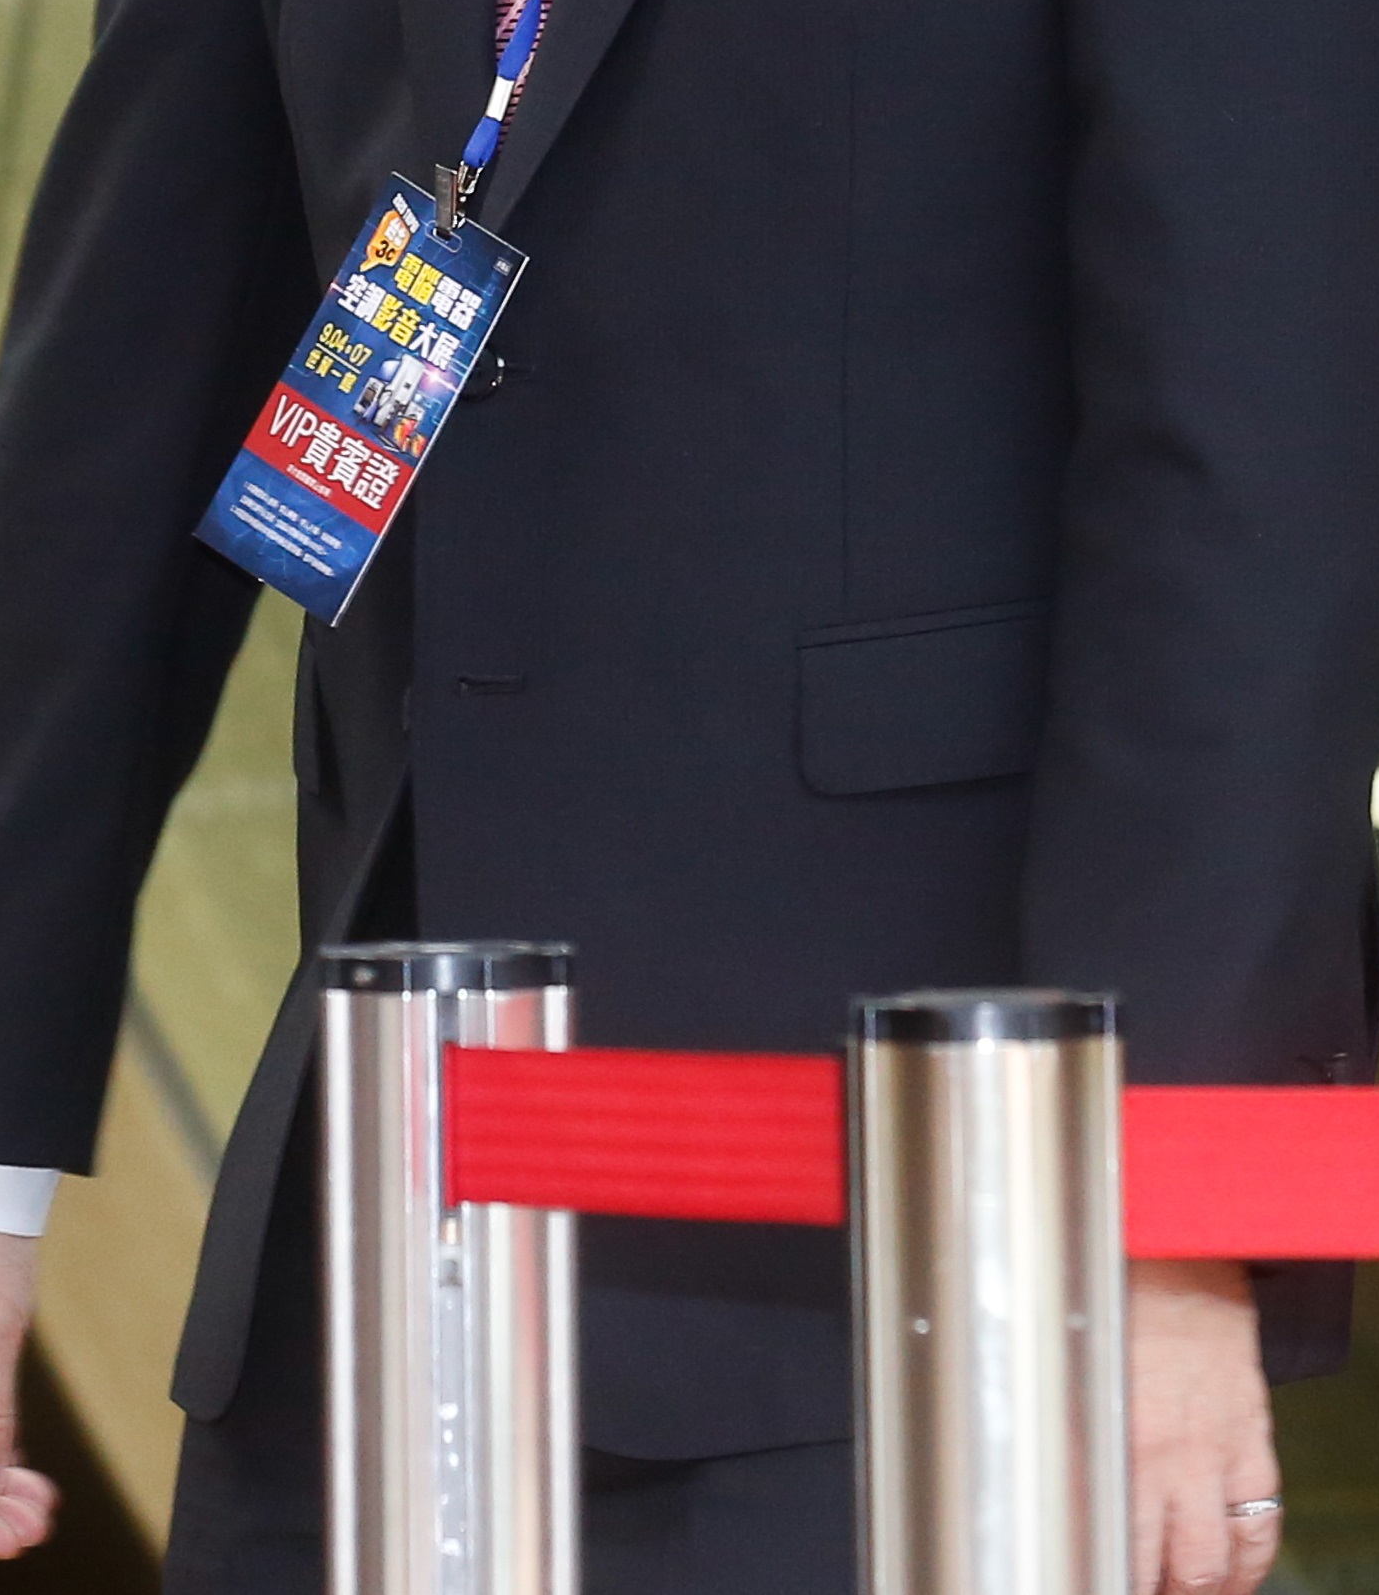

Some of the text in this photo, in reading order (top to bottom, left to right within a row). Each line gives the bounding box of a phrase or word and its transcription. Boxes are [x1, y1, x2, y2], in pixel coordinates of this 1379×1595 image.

[337, 273, 461, 371] 空調影音大展
[394, 252, 483, 331] 電腦電器
